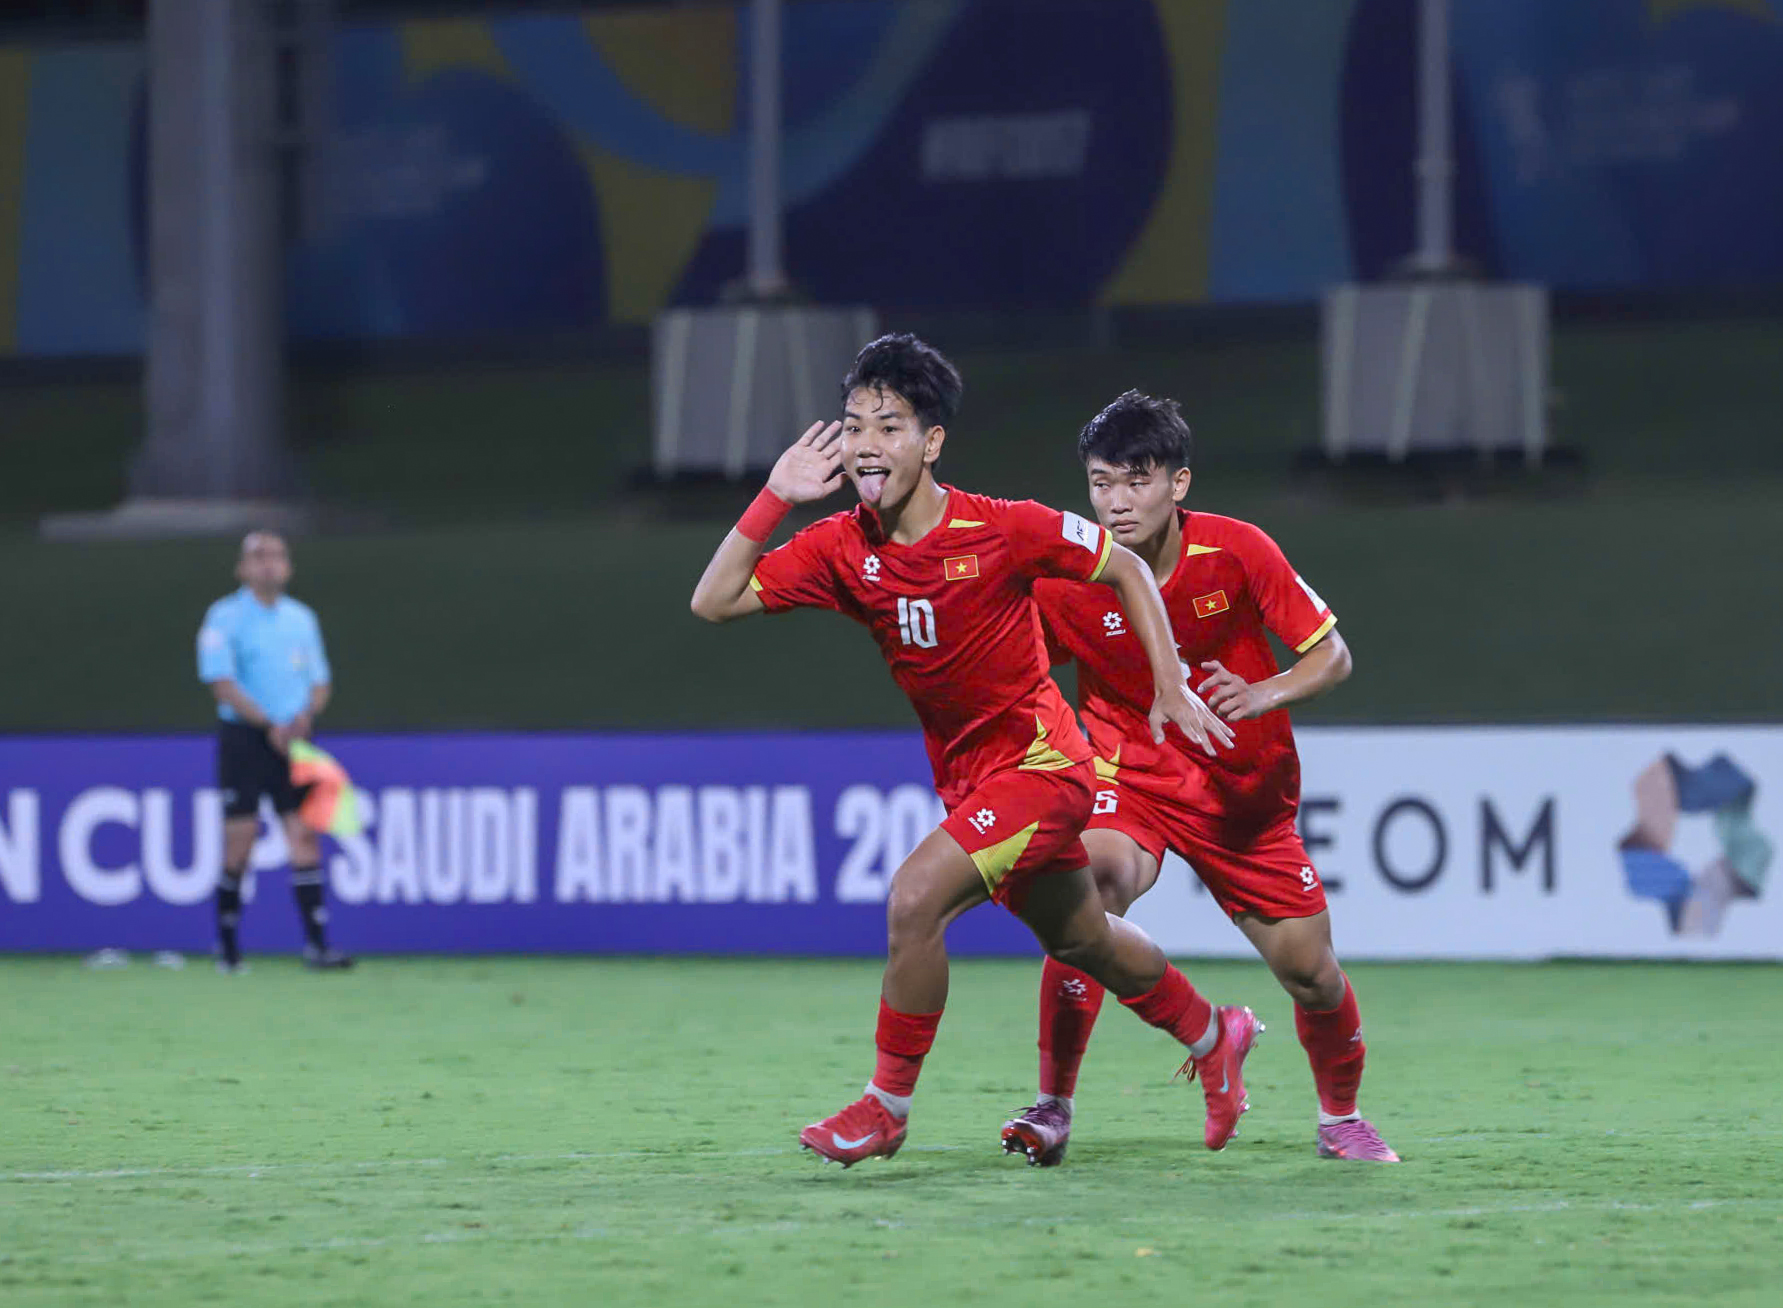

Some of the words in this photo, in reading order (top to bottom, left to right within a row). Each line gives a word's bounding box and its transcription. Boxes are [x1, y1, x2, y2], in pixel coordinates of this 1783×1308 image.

[897, 597, 938, 649] 10
[330, 786, 536, 904] SAUDI
[555, 785, 818, 903] ARABIA
[834, 783, 948, 903] 20
[1191, 796, 1558, 895] EOM
